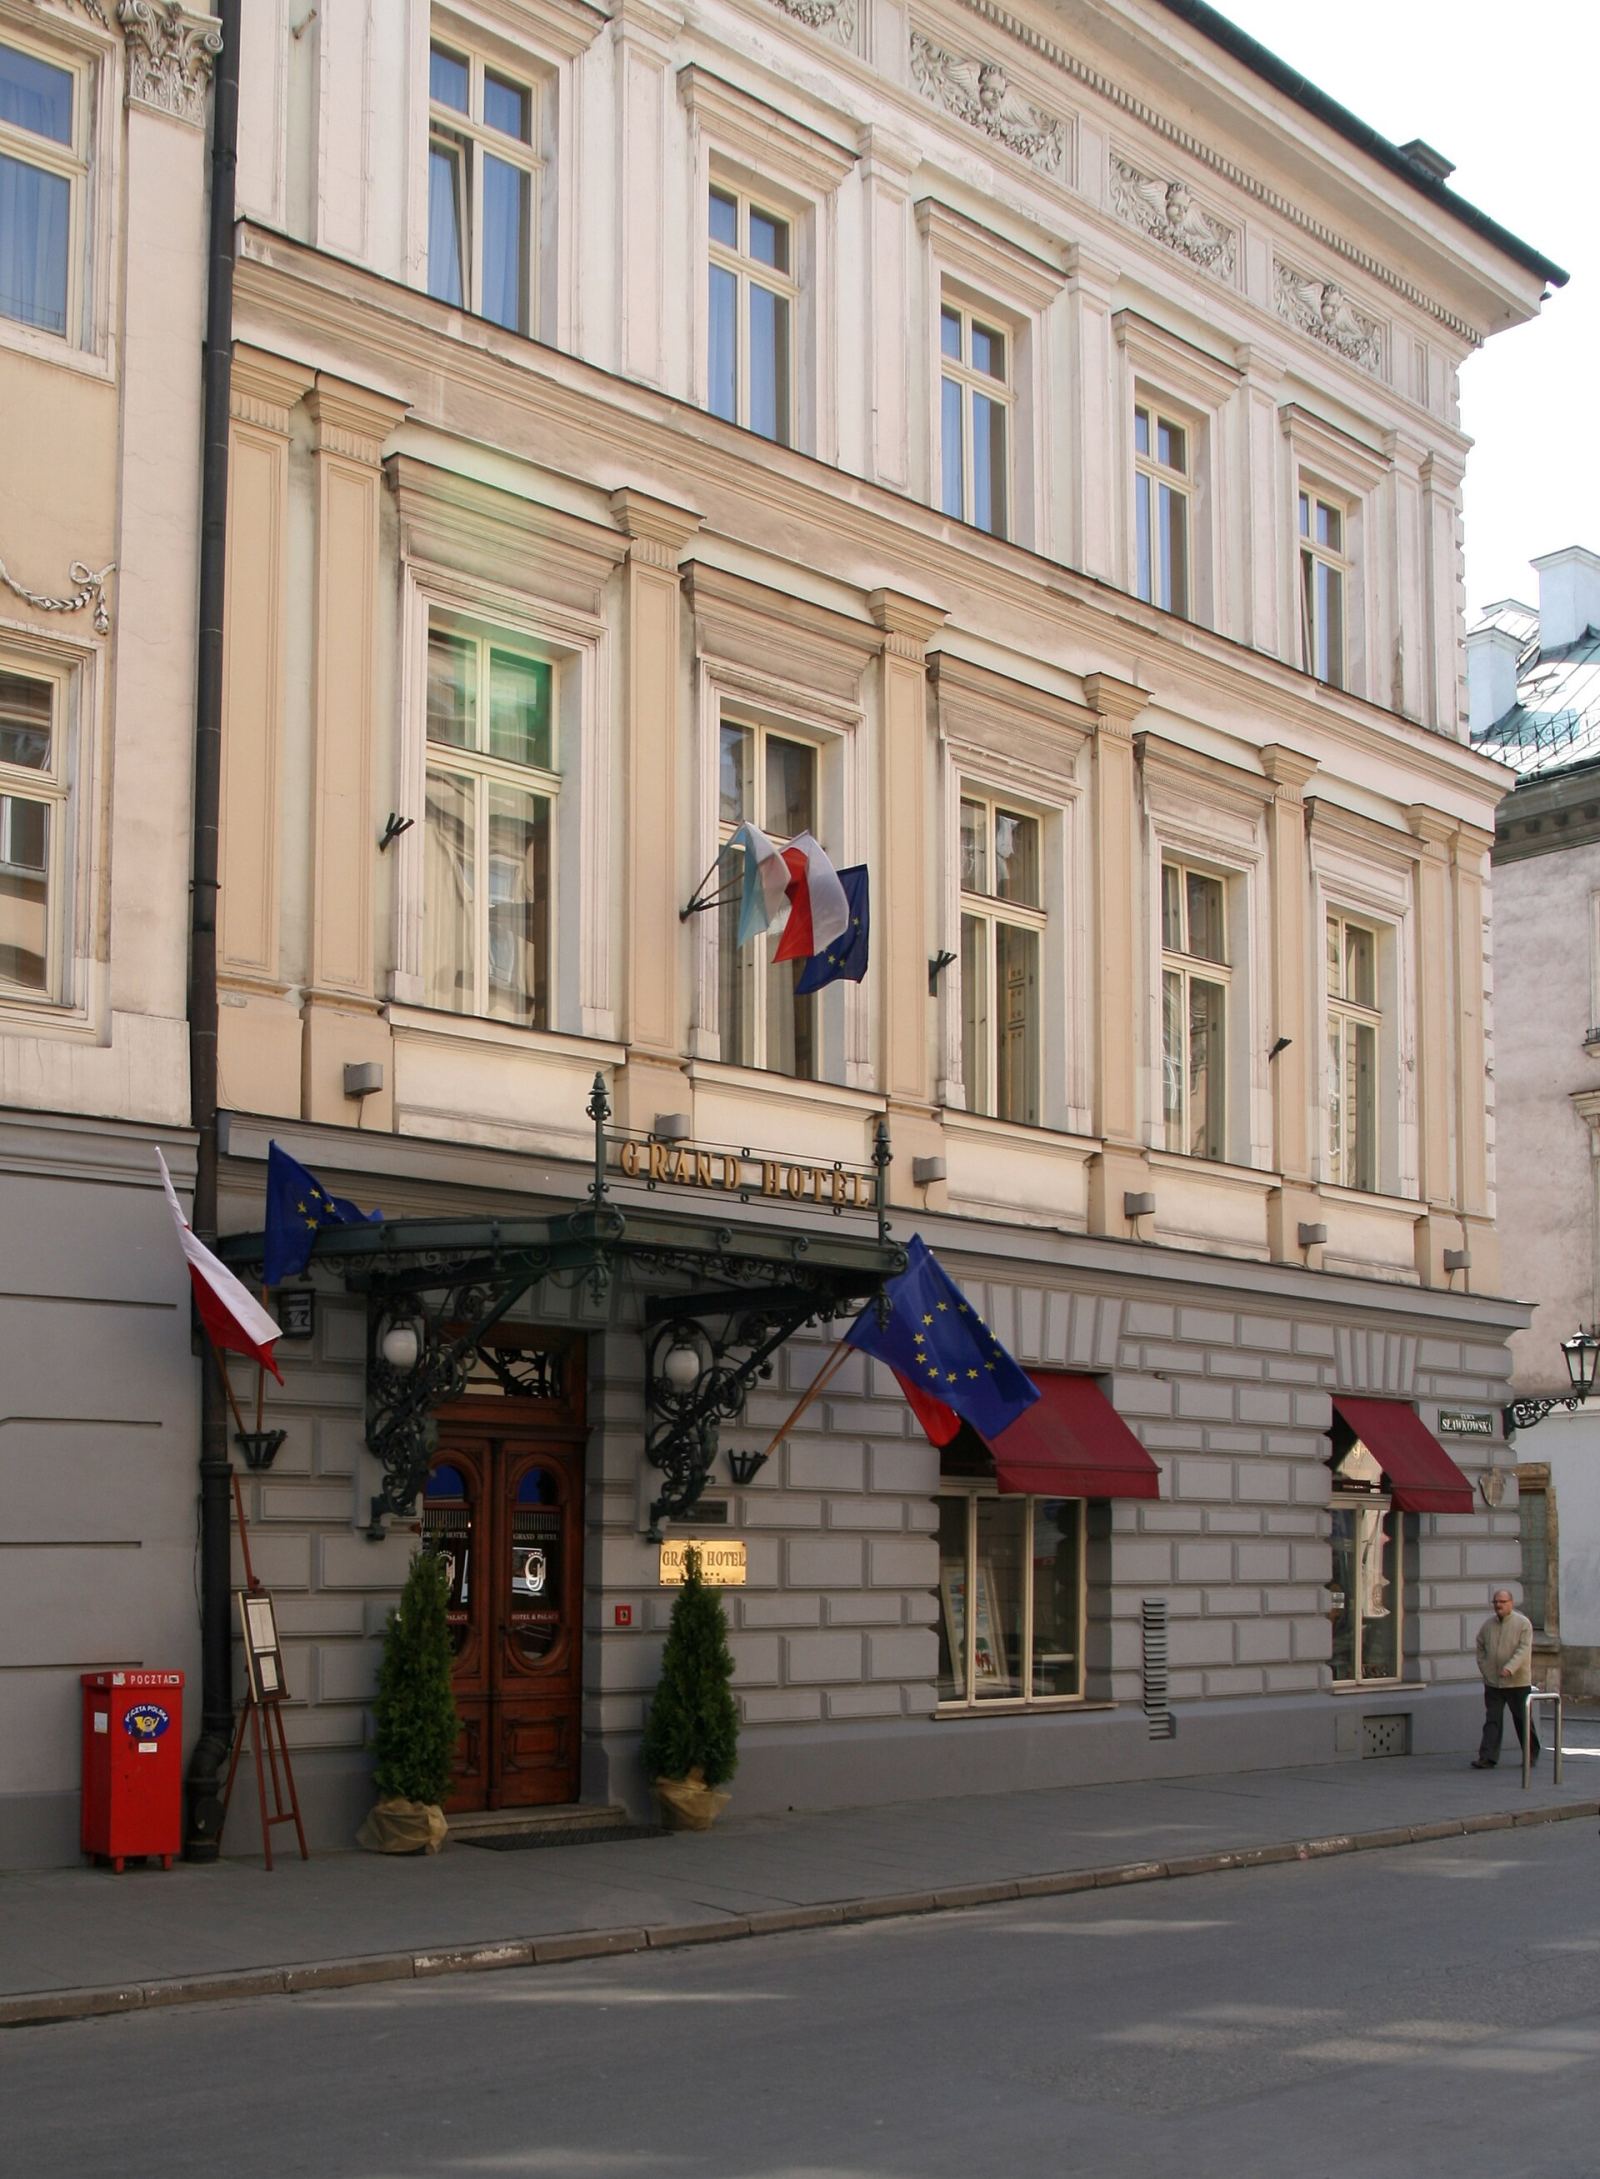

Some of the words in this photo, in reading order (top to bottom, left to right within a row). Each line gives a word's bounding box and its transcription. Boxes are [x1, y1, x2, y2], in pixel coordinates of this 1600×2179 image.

[620, 1140, 741, 1190] GRAND
[762, 1160, 869, 1208] HOTEL
[512, 1533, 535, 1541] GRAND
[707, 1551, 746, 1567] HOTEL
[130, 1674, 168, 1685] POCZTA
[147, 1705, 168, 1722] POLSKA
